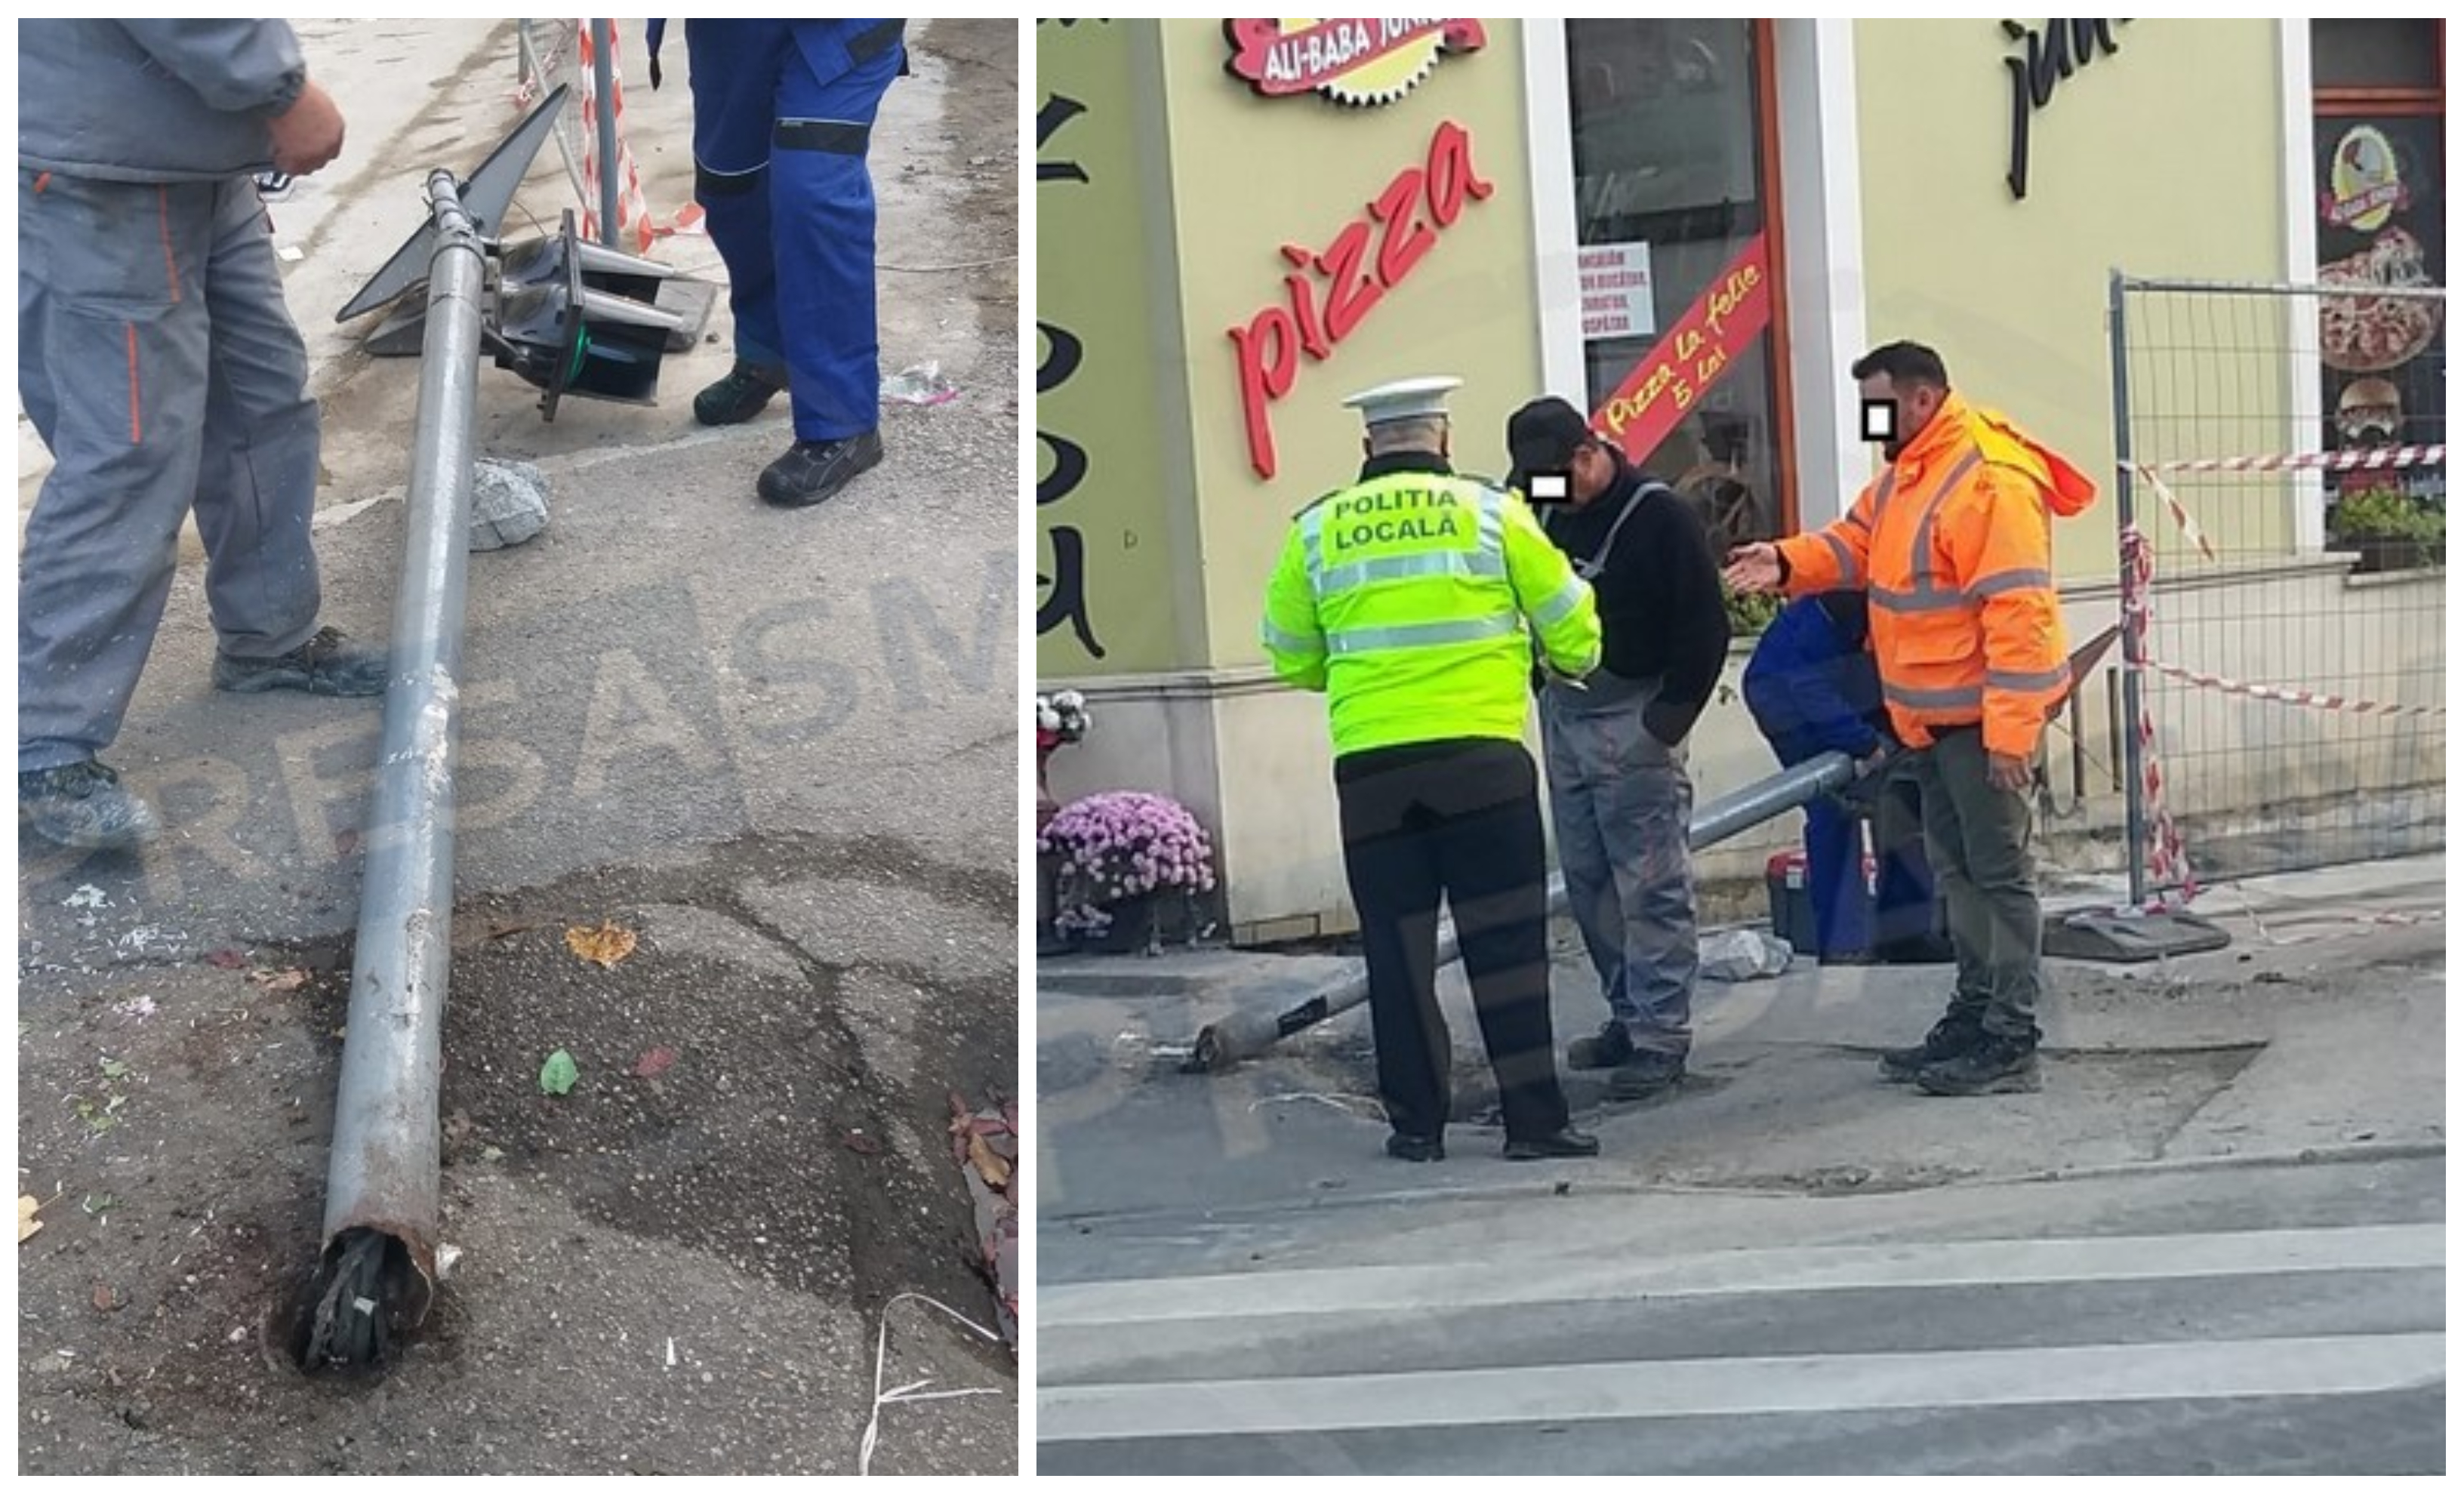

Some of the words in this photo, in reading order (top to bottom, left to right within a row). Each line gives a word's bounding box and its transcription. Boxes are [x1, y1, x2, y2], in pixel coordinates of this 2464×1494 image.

[1264, 20, 1370, 79] ALI-BABA
[1227, 120, 1493, 481] pizza
[1606, 363, 1676, 436] Pizza
[1671, 377, 1693, 409] 5
[1335, 489, 1457, 519] POLITIA
[1335, 510, 1458, 550] LOCALĂ
